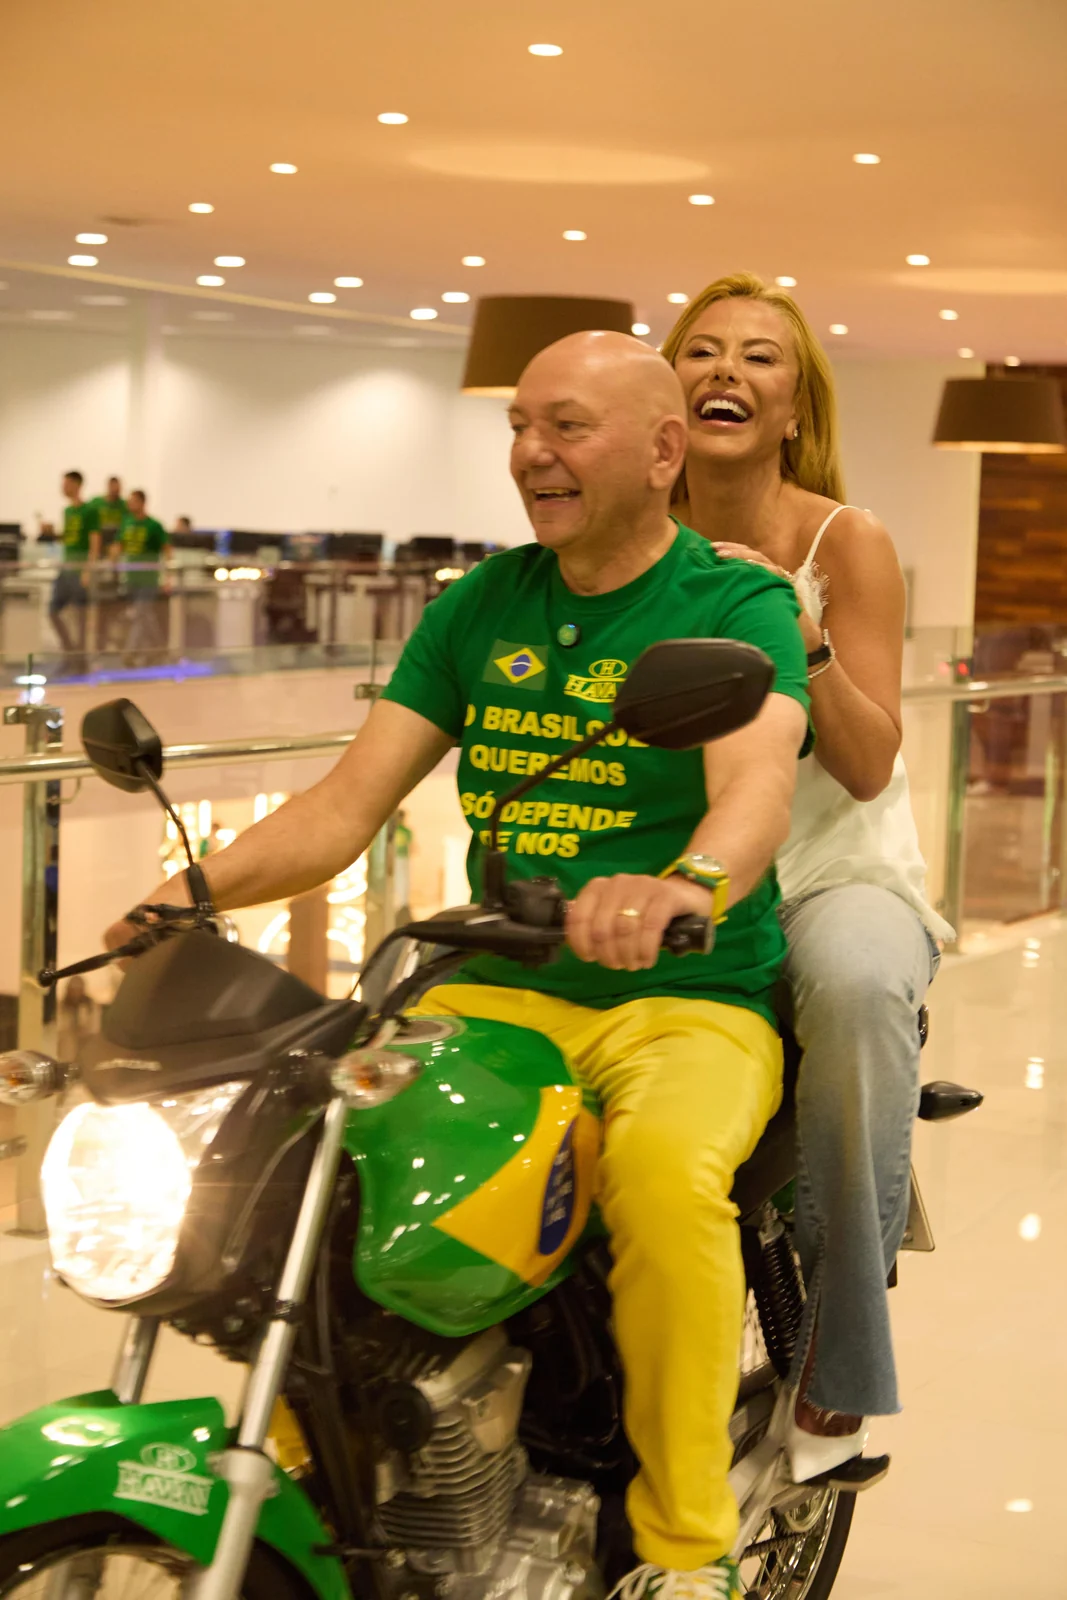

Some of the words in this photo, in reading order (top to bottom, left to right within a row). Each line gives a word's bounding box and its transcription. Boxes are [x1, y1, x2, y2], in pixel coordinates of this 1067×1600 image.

[563, 678, 618, 699] HAVA
[482, 706, 584, 742] BRASIL
[460, 791, 497, 819] SÓ
[499, 801, 637, 831] DEPENDE
[515, 832, 580, 858] NOS
